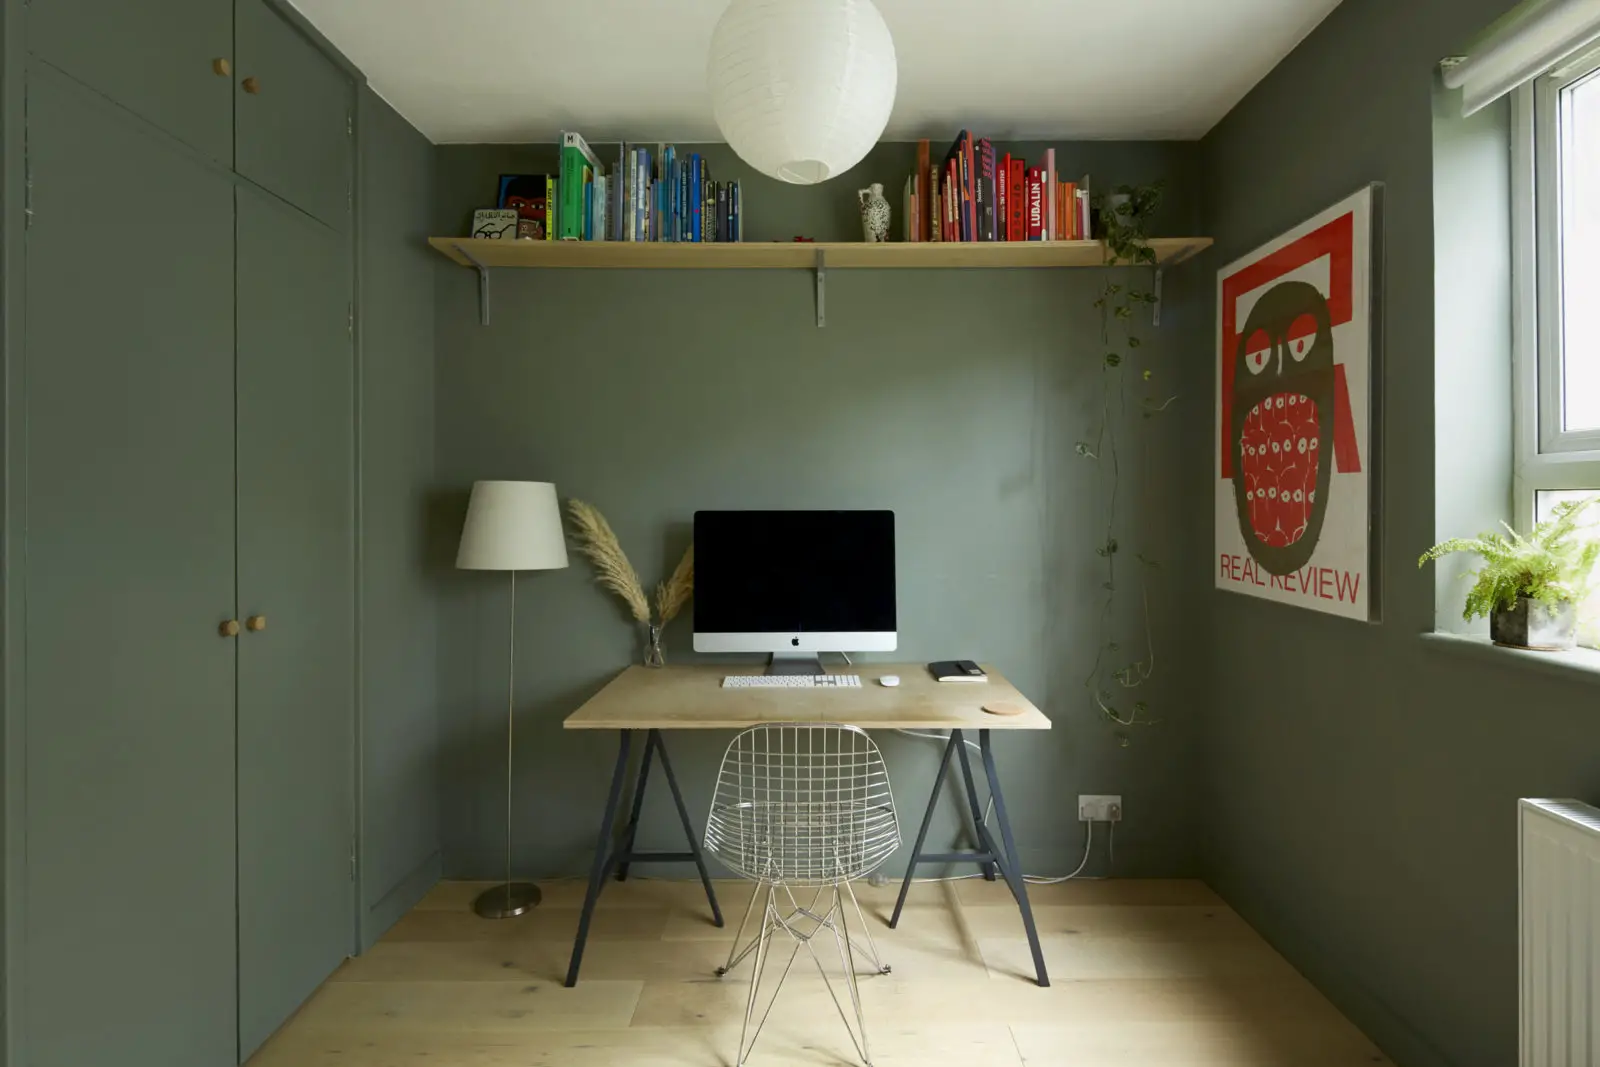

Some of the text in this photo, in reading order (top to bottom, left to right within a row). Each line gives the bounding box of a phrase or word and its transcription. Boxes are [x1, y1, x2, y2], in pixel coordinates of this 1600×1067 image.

[567, 135, 574, 144] M
[1031, 182, 1041, 226] LUBALIN
[1220, 554, 1266, 586] REAL
